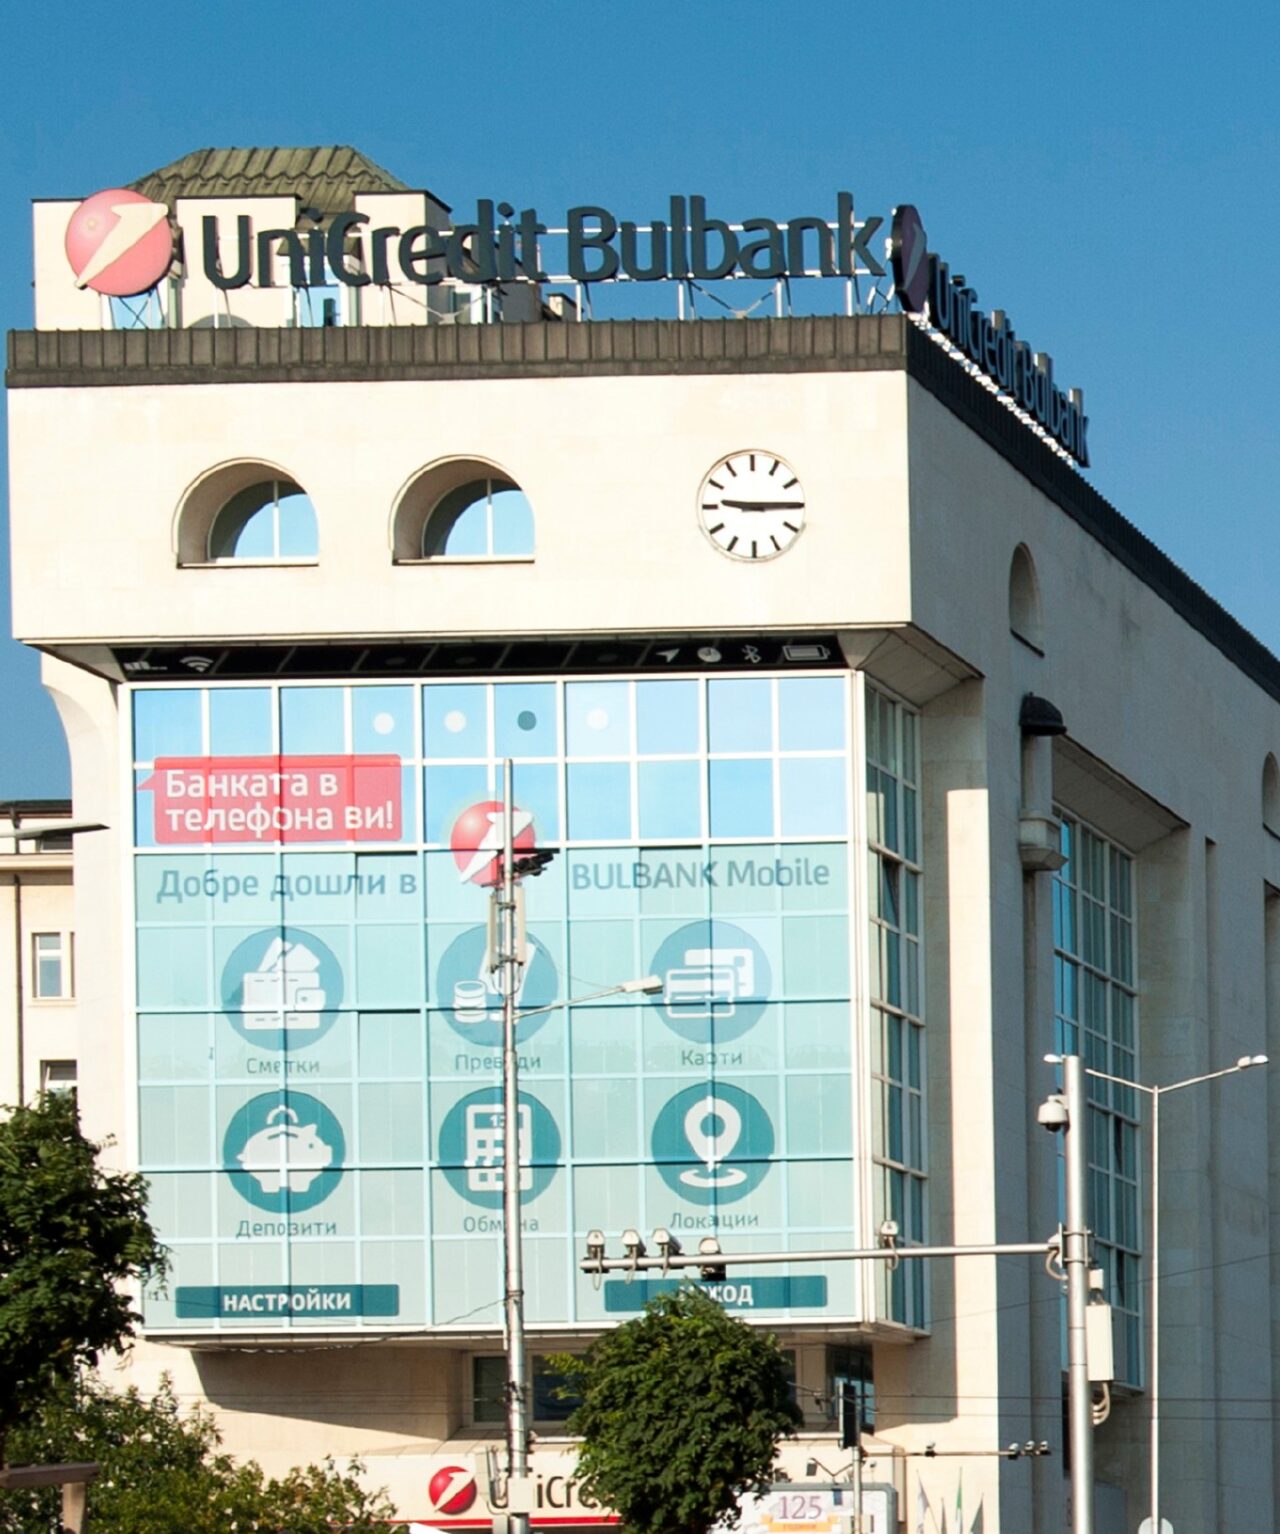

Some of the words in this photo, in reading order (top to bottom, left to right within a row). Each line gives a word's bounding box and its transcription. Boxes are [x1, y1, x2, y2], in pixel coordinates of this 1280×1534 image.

[202, 198, 548, 289] UniCredit
[566, 191, 886, 281] Bulbank
[928, 253, 1017, 399] UniCredit
[1015, 340, 1090, 468] Bulbank
[165, 769, 309, 798] Банката
[319, 772, 338, 796] в
[165, 802, 334, 838] телефона
[344, 800, 394, 830] ви!
[156, 868, 259, 904] Добре
[270, 874, 386, 902] дошли
[400, 874, 417, 894] в
[572, 860, 719, 890] BULBANK
[726, 857, 830, 887] Mobile
[246, 1057, 320, 1074] Сметки
[455, 1053, 541, 1073] Превди
[236, 1220, 337, 1239] Депозити
[463, 1215, 539, 1233] Обмна
[670, 1212, 759, 1230] Локации
[223, 1287, 351, 1312] НАСТРОЙКИ
[679, 1284, 754, 1306] ХОД
[778, 1495, 822, 1520] 125
